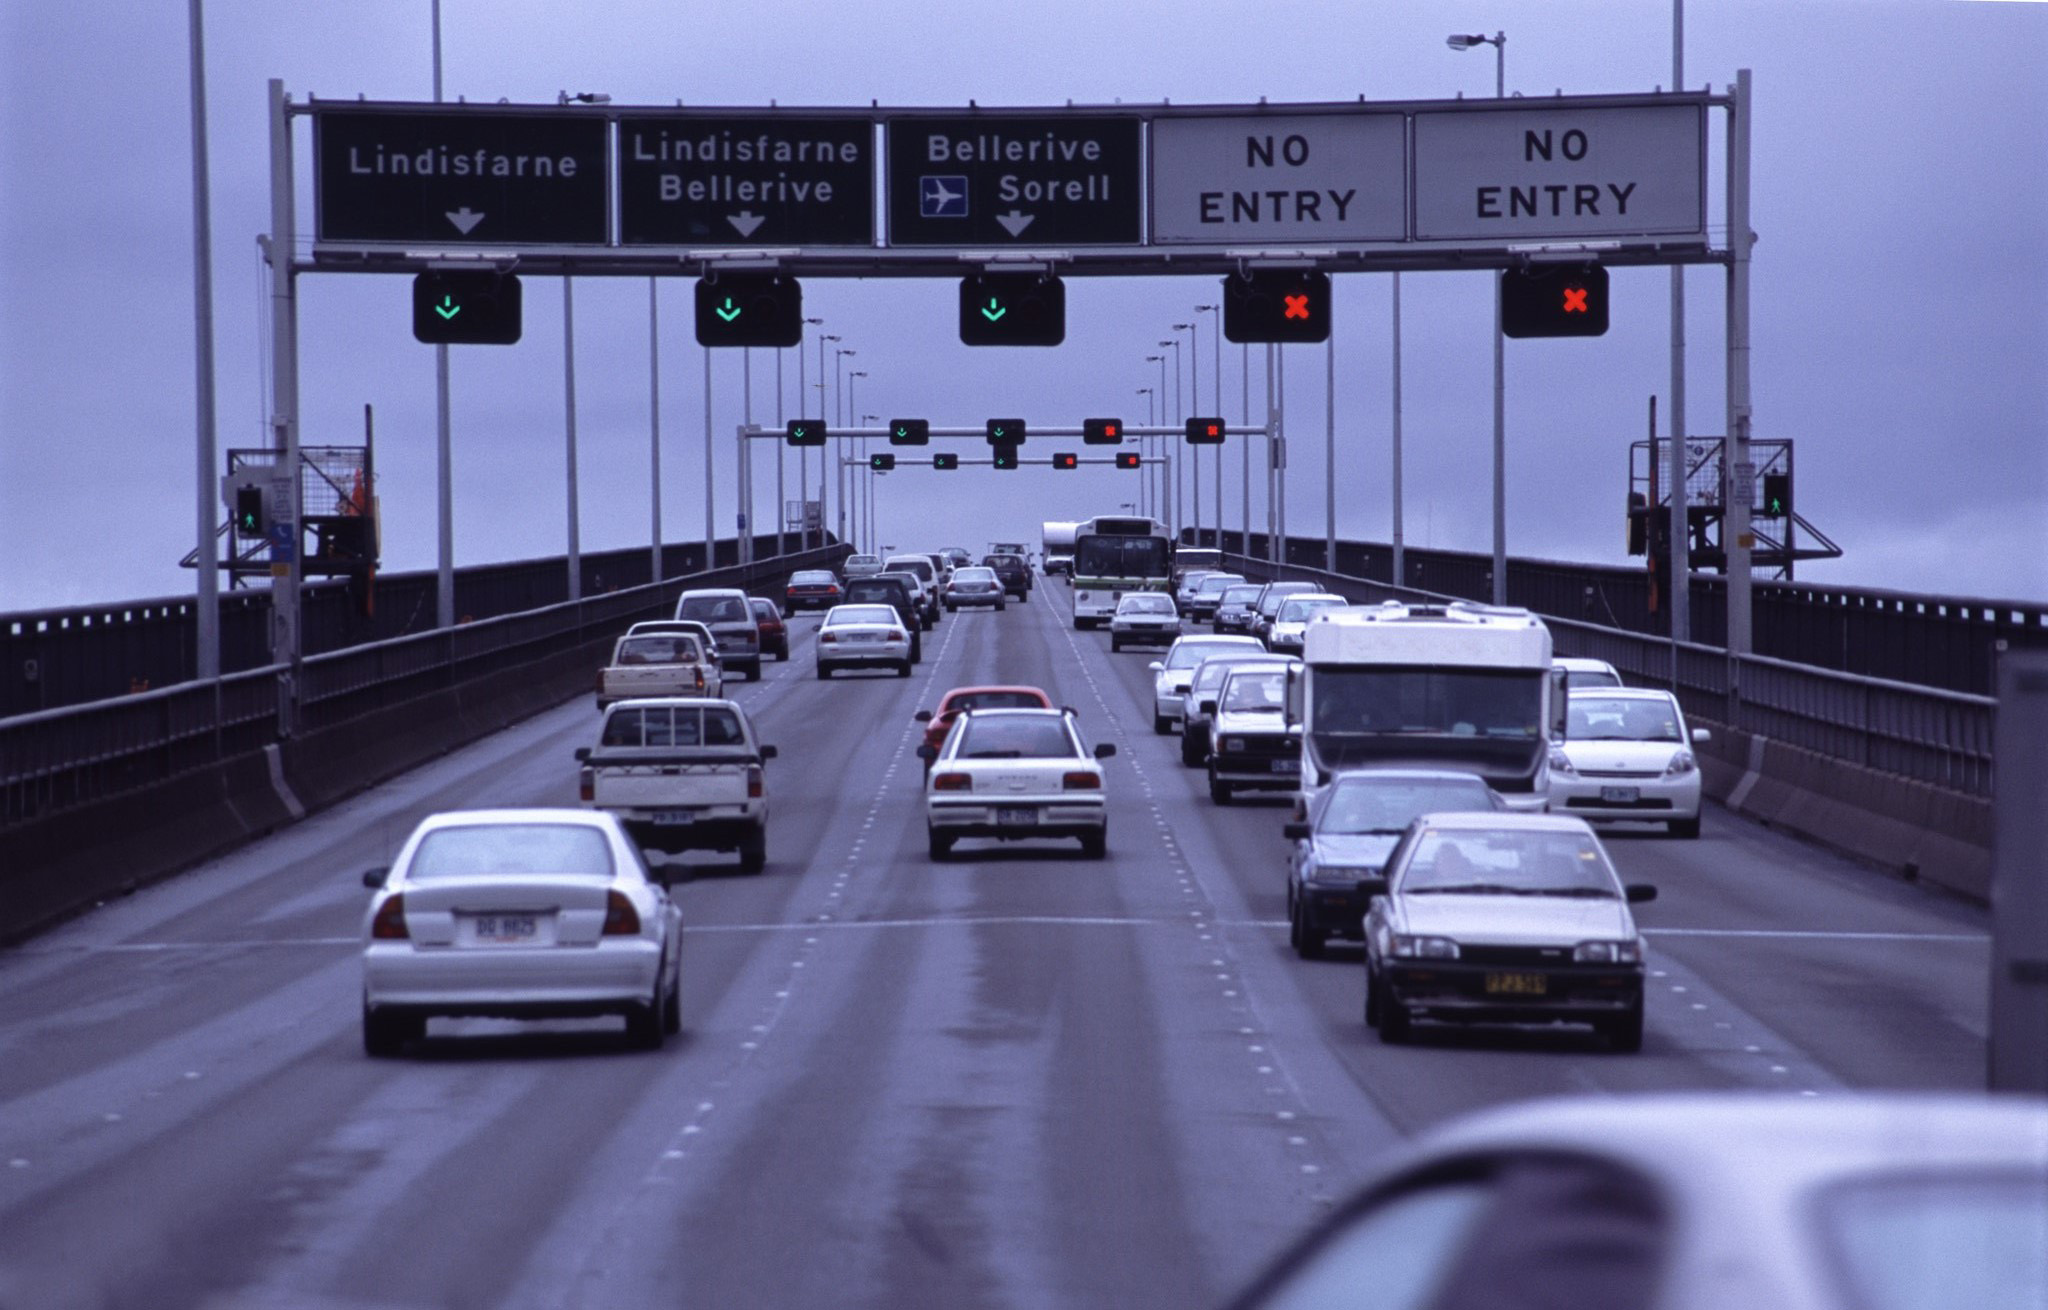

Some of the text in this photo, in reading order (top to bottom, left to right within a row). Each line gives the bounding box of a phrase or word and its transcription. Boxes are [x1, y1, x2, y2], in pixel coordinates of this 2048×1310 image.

[350, 144, 577, 177] Lindisfarne
[634, 130, 858, 163] Lindisfarne
[928, 132, 1100, 162] Bellerive
[1246, 134, 1310, 168] NO
[1524, 128, 1589, 162] NO
[660, 172, 833, 202] Bellerive
[999, 174, 1109, 202] Sorell
[1476, 182, 1637, 219] ENTRY
[1199, 189, 1356, 224] ENTRY
